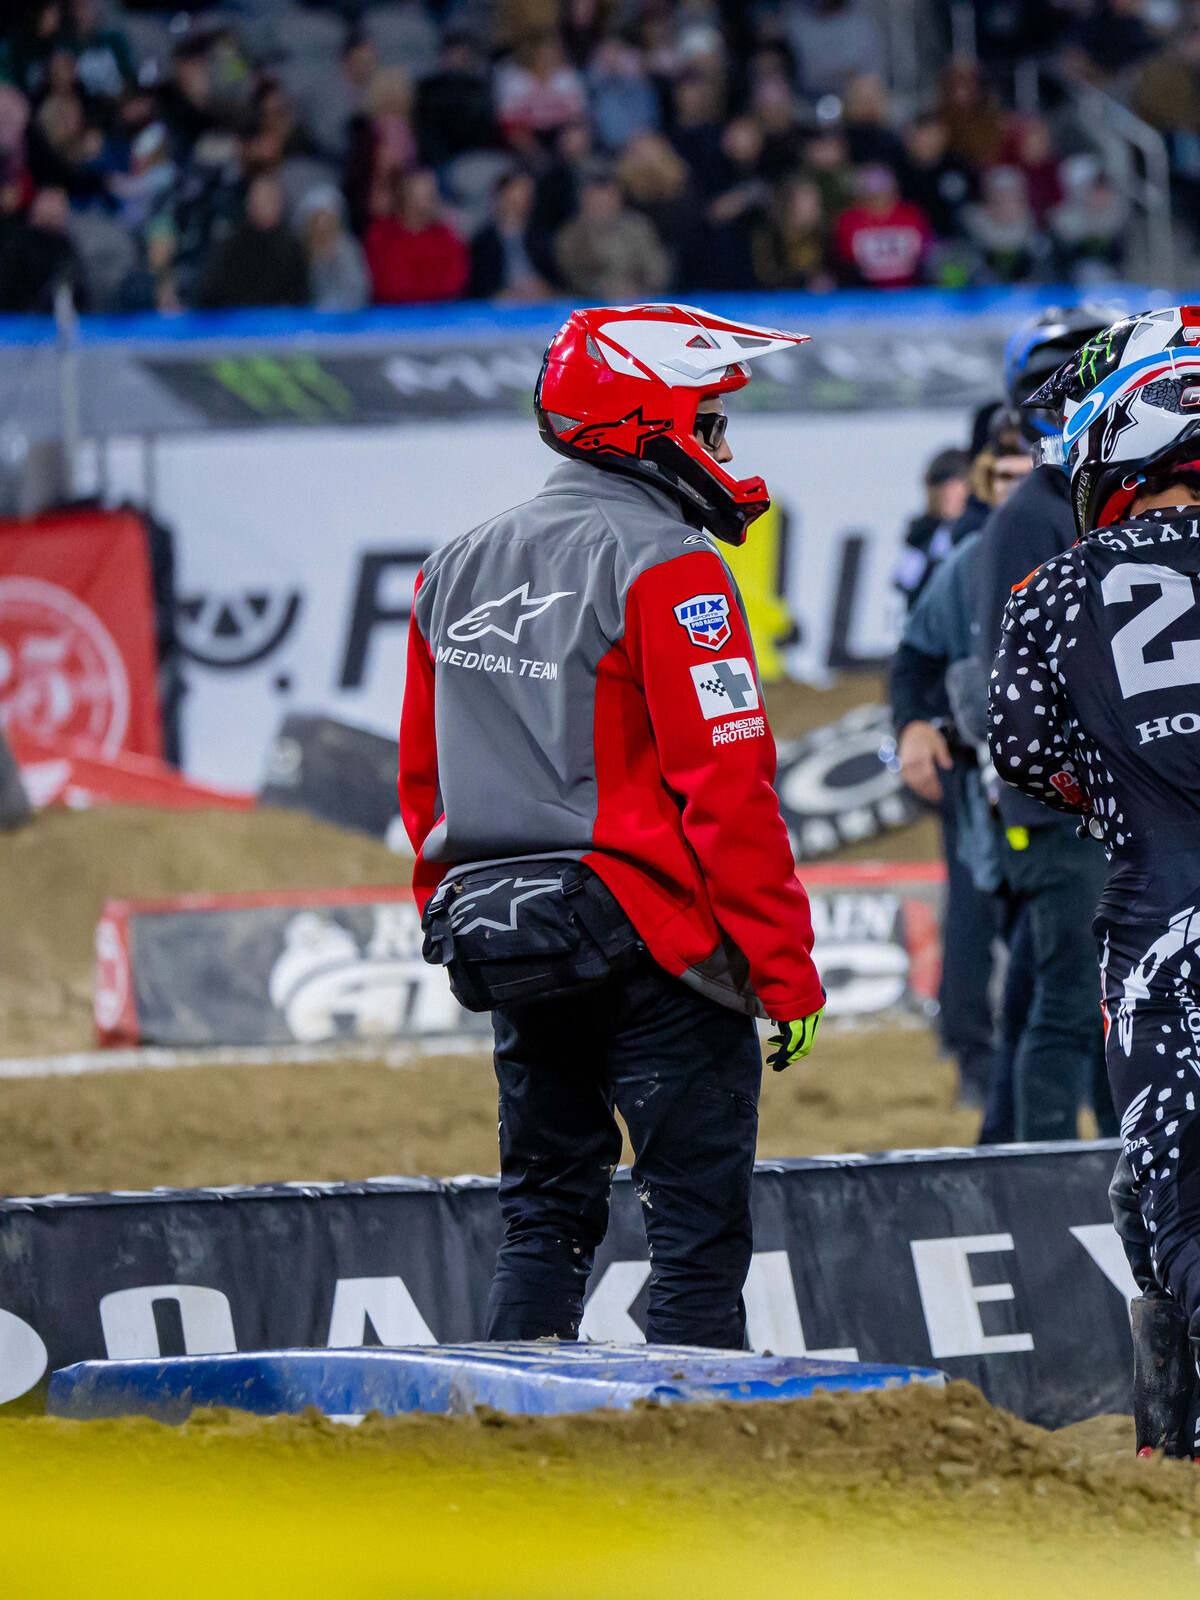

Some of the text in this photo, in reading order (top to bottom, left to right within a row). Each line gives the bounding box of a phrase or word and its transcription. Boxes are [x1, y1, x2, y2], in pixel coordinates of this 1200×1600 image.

[691, 616, 723, 629] PRO RACING
[692, 612, 719, 621] SPORTS
[435, 646, 558, 681] MEDICAL TEAM
[711, 716, 765, 736] ALPINESTARS
[712, 725, 766, 747] PROTECTS
